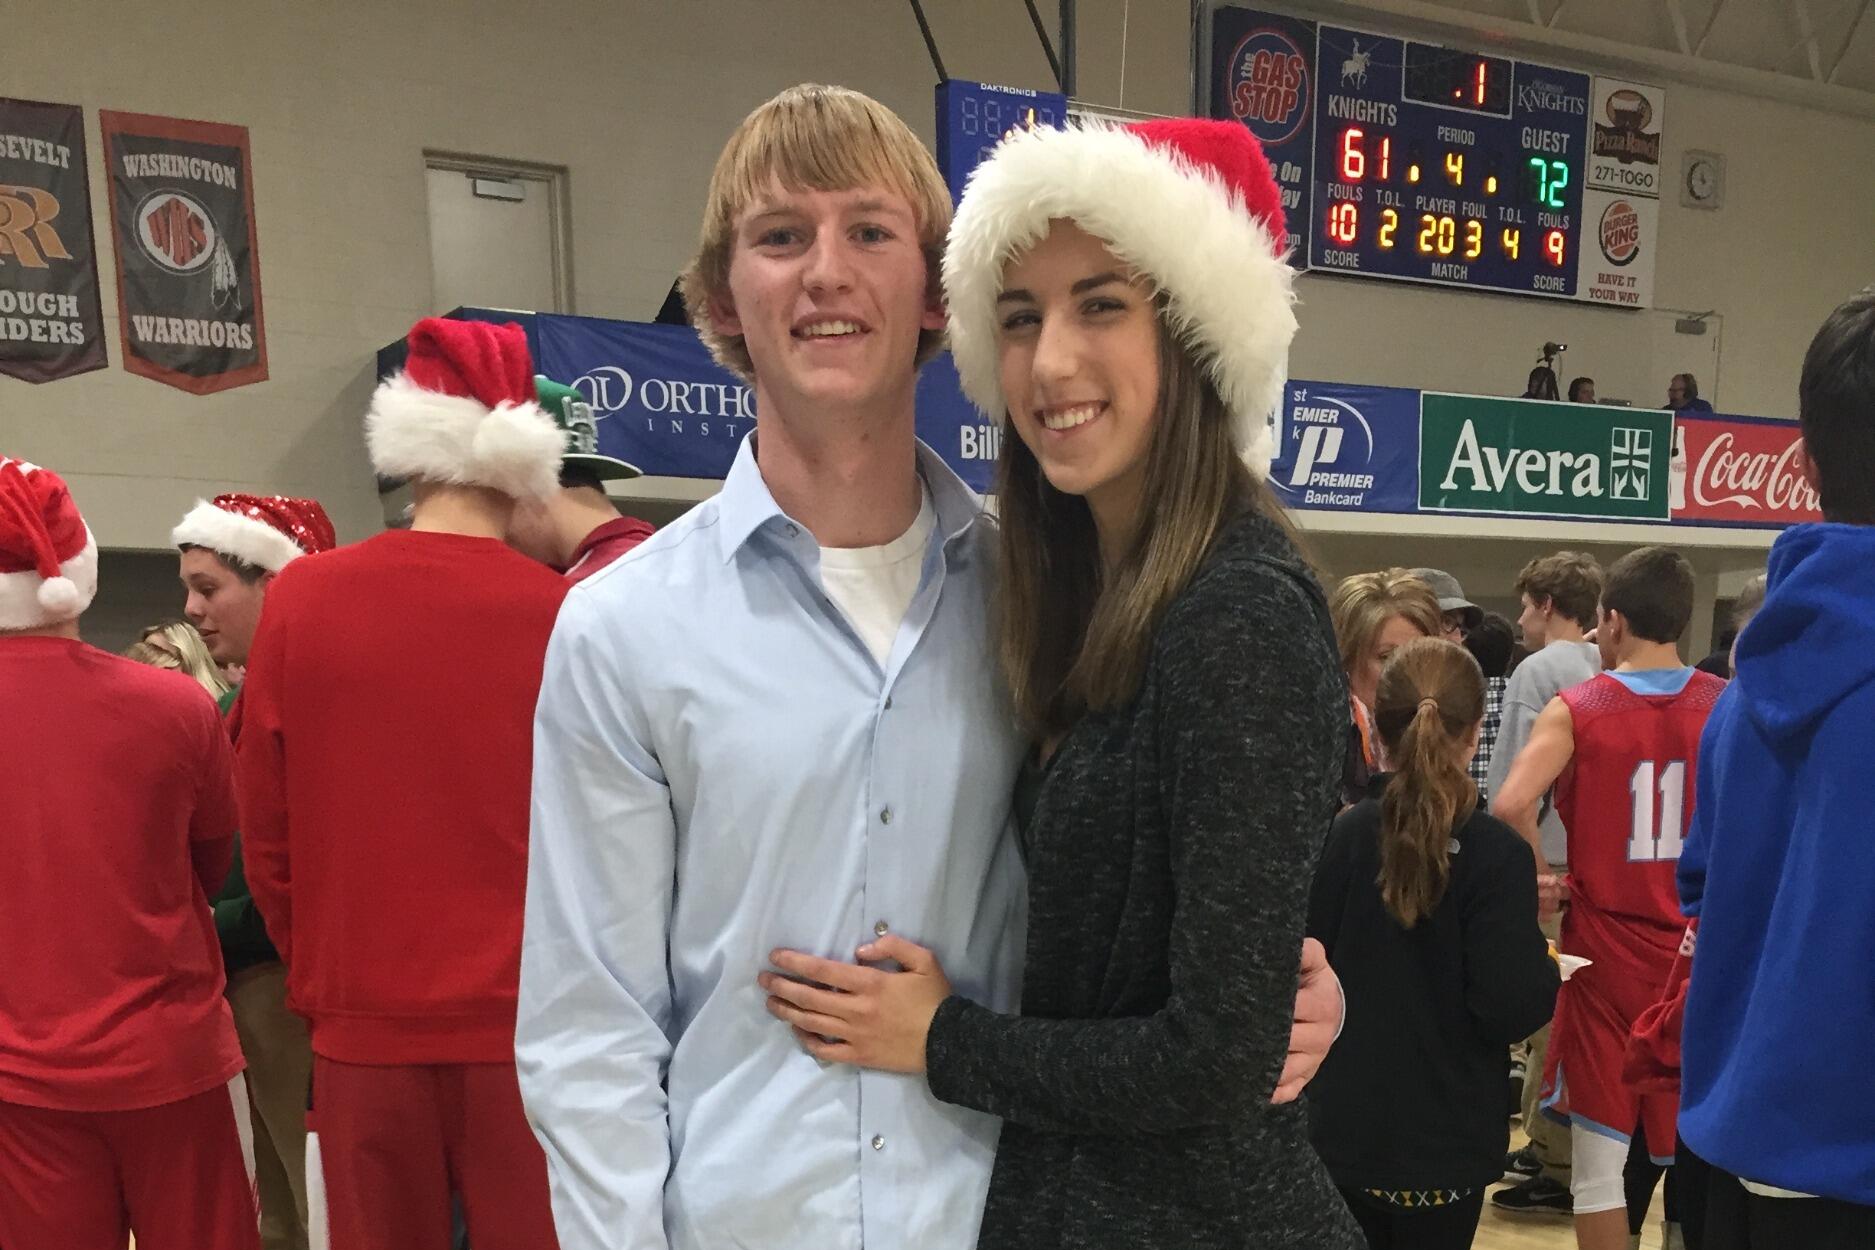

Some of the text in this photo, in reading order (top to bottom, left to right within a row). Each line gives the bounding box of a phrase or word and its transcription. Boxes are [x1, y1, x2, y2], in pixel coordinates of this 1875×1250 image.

[1240, 52, 1254, 77] the
[1251, 49, 1304, 90] GAS
[980, 82, 1037, 98] DAKTRONICS
[1517, 84, 1585, 116] KNIGHTS
[1233, 81, 1299, 124] STOP
[1328, 94, 1398, 127] KNIGHTS
[1437, 125, 1475, 146] PERIOD
[1521, 126, 1571, 155] GUEST
[1344, 128, 1389, 180] 61
[123, 154, 236, 190] WASHINGTON
[1280, 161, 1302, 183] On
[1446, 153, 1463, 185] 4
[1595, 166, 1653, 188] 271-TOGO
[1327, 182, 1363, 201] FOULS
[1530, 157, 1568, 207] 72
[1376, 189, 1405, 207] T.O.L.
[1416, 195, 1488, 219] PLAYER FOUL
[1331, 203, 1357, 241] 10
[1499, 206, 1526, 224] T.O.L.
[1537, 211, 1570, 229] FOULS
[1604, 213, 1637, 234] BURGER
[1380, 209, 1397, 247] 2
[1420, 214, 1482, 257] 20 3
[1605, 225, 1639, 249] KING
[1503, 228, 1520, 260] 4
[1548, 231, 1564, 265] 9
[1324, 249, 1360, 268] SCORE
[1431, 262, 1468, 281] MATCH
[1533, 274, 1565, 292] SCORE
[1598, 273, 1637, 288] HAVE IT
[0, 290, 79, 318] OUGH
[1589, 288, 1640, 304] YOUR WAY
[132, 315, 252, 349] WARRIORS
[1293, 388, 1307, 402] st
[1293, 407, 1339, 423] EMIER
[1440, 418, 1604, 497] Avera
[1310, 472, 1374, 489] PREMIER
[1693, 432, 1822, 512] Coca-Co
[1304, 490, 1363, 506] Bankcard
[1627, 760, 1686, 862] 11
